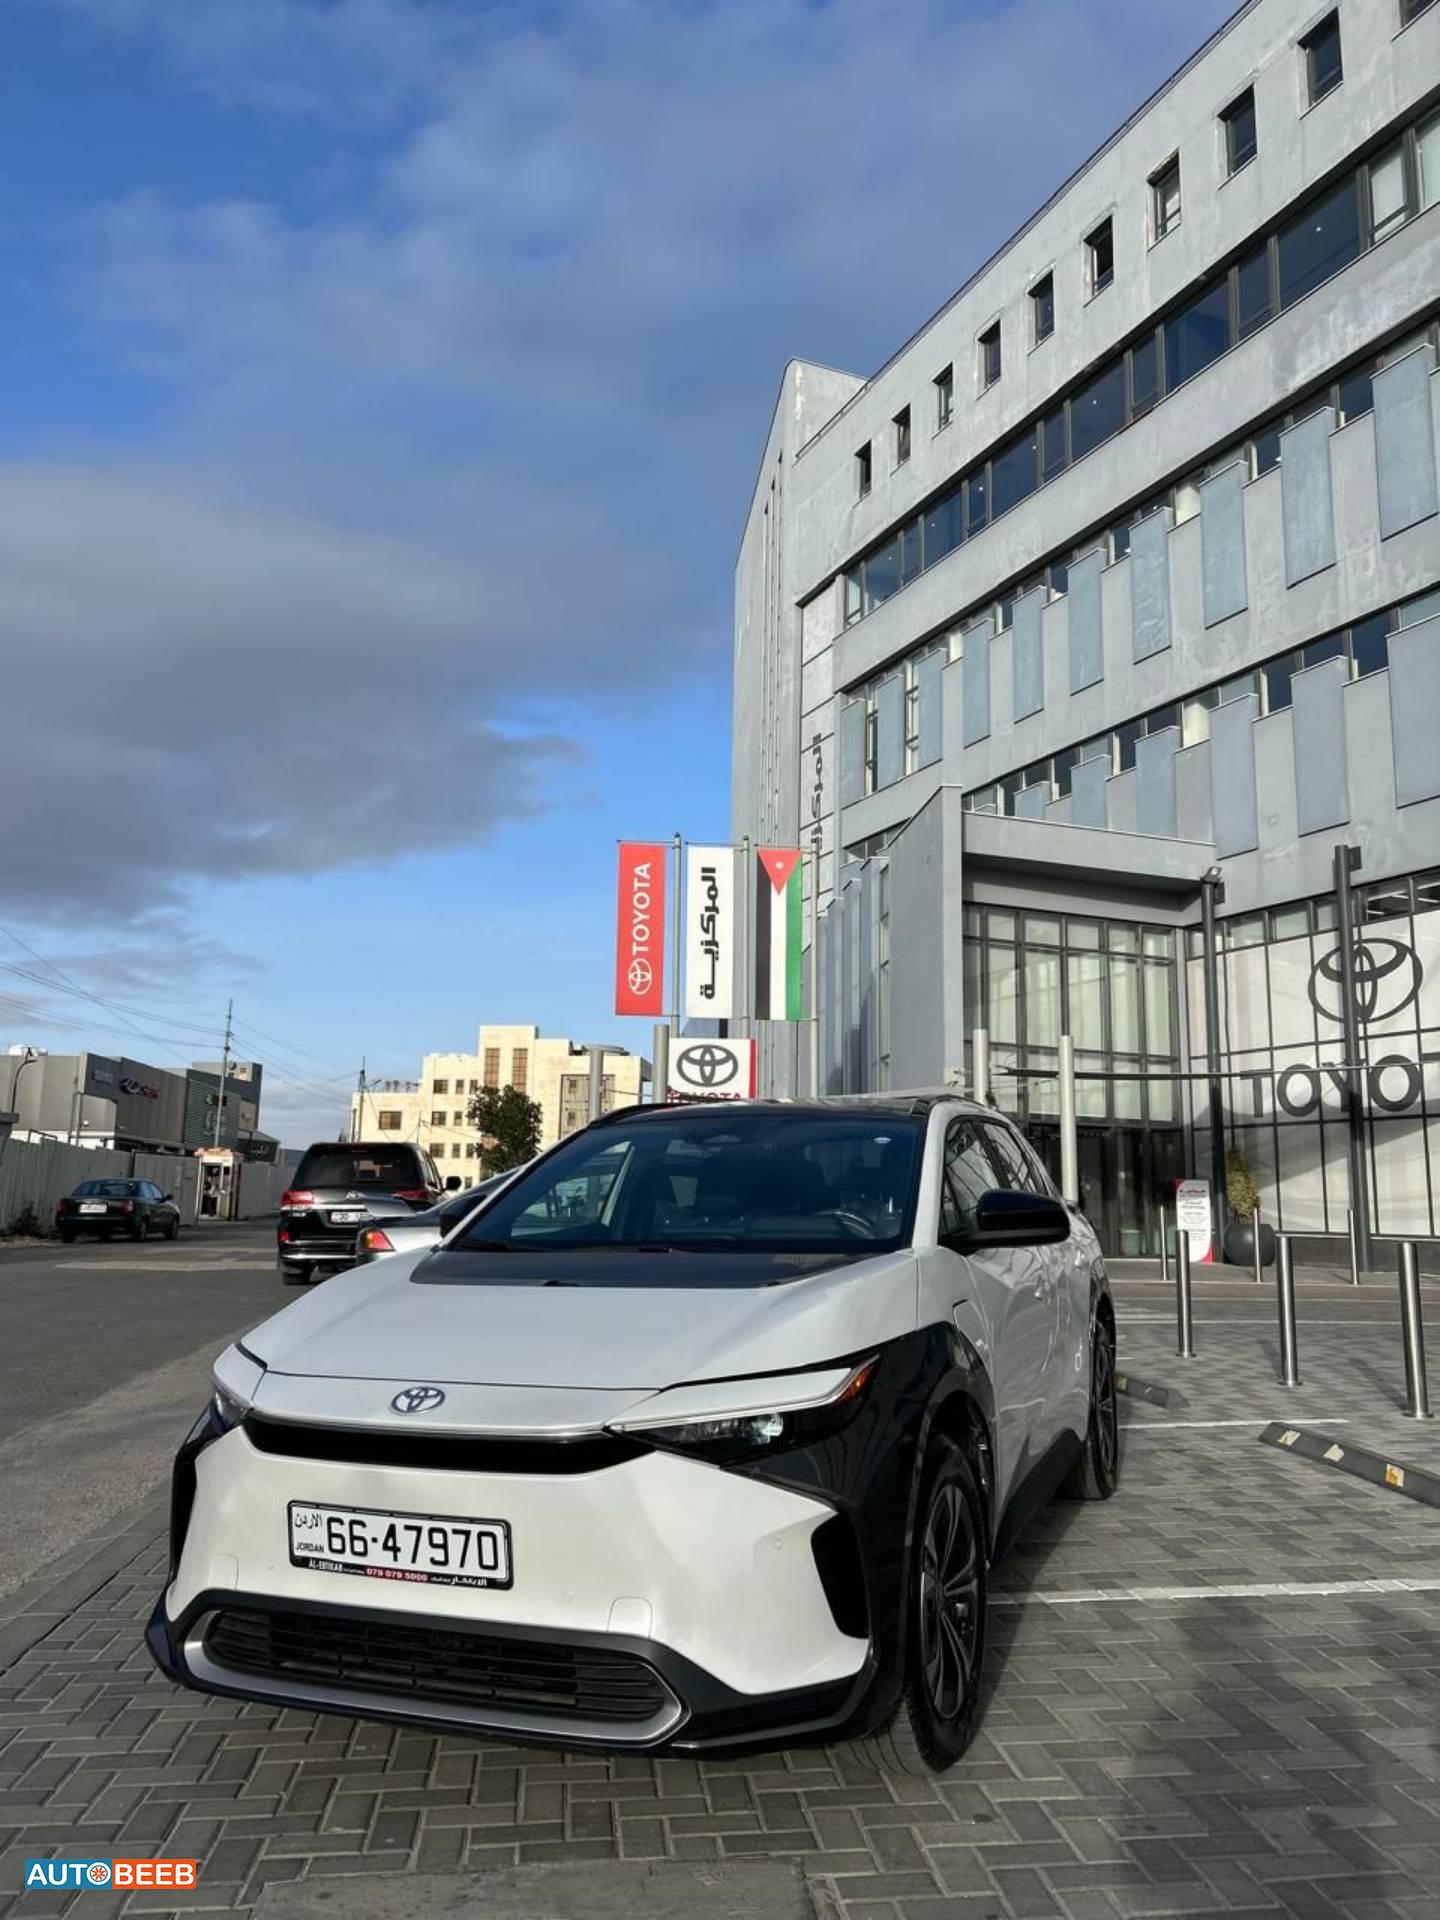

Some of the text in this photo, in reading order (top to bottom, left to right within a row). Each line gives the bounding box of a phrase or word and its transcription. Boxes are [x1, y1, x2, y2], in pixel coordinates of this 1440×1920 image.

[632, 862, 651, 954] TOYOTA
[700, 867, 719, 999] المركزية
[296, 1542, 325, 1552] JORDAN
